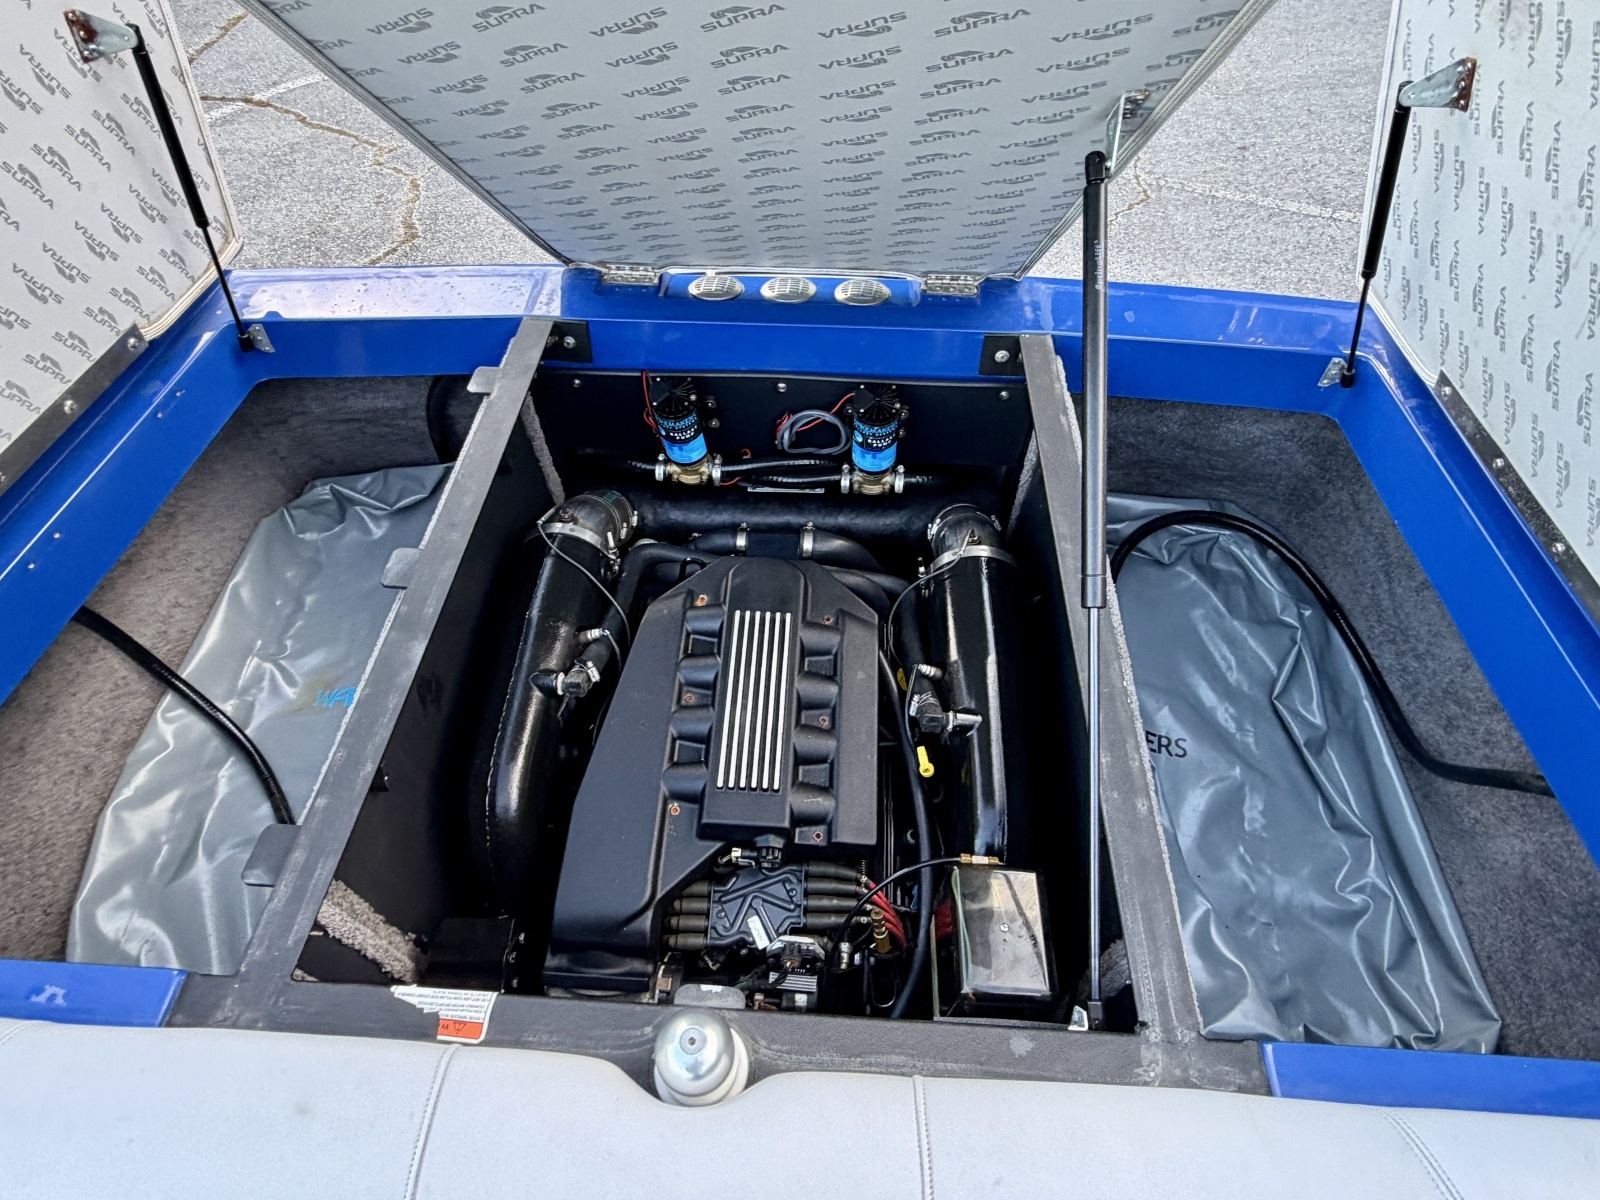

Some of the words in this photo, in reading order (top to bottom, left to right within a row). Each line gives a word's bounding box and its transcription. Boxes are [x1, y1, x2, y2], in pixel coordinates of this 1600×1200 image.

[274, 0, 312, 14] PRA
[471, 4, 546, 33] SUPRA
[700, 4, 786, 33] SUPRA
[366, 9, 435, 35] SUPRA
[589, 7, 668, 37] SUPRA
[817, 12, 908, 39] SUPRA
[933, 10, 1031, 38] SUPRA
[1050, 14, 1154, 44] SUPRA
[1172, 15, 1234, 37] SUP
[317, 39, 354, 50] PRA
[1527, 2, 1536, 69] UPRA
[1554, 0, 1566, 87] SUPRA
[397, 42, 462, 65] SUPRA
[499, 42, 569, 68] SUPRA
[605, 42, 679, 68] SUPRA
[710, 44, 791, 69] SUPRA
[817, 45, 902, 70] SUPRA
[925, 48, 1015, 74] SUPRA
[1035, 48, 1131, 74] SUPRA
[1588, 20, 1600, 110] SUPRA
[20, 43, 72, 100] SUPRA
[349, 67, 386, 78] PRA
[428, 74, 489, 94] SUPRA
[519, 72, 586, 94] SUPRA
[0, 70, 44, 115] SUPR
[621, 76, 691, 98] SUPRA
[717, 74, 792, 96] SUPRA
[818, 79, 897, 101] SUPRA
[919, 78, 1003, 100] SUPRA
[1020, 81, 1108, 104] SUPRA
[451, 99, 510, 118] SUPRA
[541, 101, 603, 120] SUPRA
[633, 102, 699, 121] SUPRA
[724, 104, 795, 123] SUPRA
[819, 105, 893, 124] SUPRA
[913, 107, 991, 126] SUPRA
[1010, 105, 1092, 127] SUPRA
[1496, 79, 1506, 156] SUPRA
[92, 109, 135, 157] SUPRA
[475, 124, 531, 140] SUPRA
[556, 124, 616, 140] SUPRA
[646, 127, 708, 144] SUPRA
[731, 126, 796, 143] SUPRA
[820, 131, 889, 147] SUPRA
[908, 129, 981, 147] SUPRA
[998, 131, 1075, 150] SUPRA
[1524, 100, 1535, 179] SUPRA
[64, 124, 112, 173] SUPRA
[494, 144, 546, 159] SUPRA
[573, 146, 630, 161] SUPRA
[655, 147, 714, 162] SUPRA
[737, 148, 800, 164] SUPRA
[821, 150, 886, 165] SUPRA
[904, 151, 972, 167] SUPRA
[989, 150, 1061, 168] SUPRA
[1550, 120, 1562, 201] SUPRA
[31, 143, 82, 192] SUPRA
[586, 163, 640, 177] SUPRA
[666, 166, 722, 181] SUPRA
[742, 166, 802, 180] SUPRA
[900, 169, 966, 183] SUPRA
[0, 160, 54, 210] SUPRA
[151, 167, 187, 209] SUPRA
[1583, 144, 1597, 228] SUPRA
[129, 183, 169, 225] SUPRA
[101, 202, 143, 244] SUPRA
[1499, 185, 1509, 257] SUPRA
[74, 220, 120, 262] SUPRA
[1527, 210, 1538, 284] SUPRA
[42, 242, 91, 284] SUPRA
[158, 249, 195, 284] SUPRA
[1553, 234, 1565, 310] SUPRA
[12, 262, 64, 305] SUPRA
[136, 266, 175, 302] SUPRA
[109, 286, 151, 325] SUPRA
[1586, 261, 1599, 341] SUPRA
[83, 306, 122, 337] SUPR
[1498, 285, 1507, 354] SUPRA
[1526, 313, 1536, 383] SUPRA
[1481, 356, 1489, 419] SUPRA
[1551, 339, 1562, 412] SUPRA
[0, 380, 41, 414] UPRA
[1582, 372, 1594, 447] SUPRA
[1503, 381, 1512, 446] SUPRA
[1530, 413, 1539, 479] SUPRA
[1555, 441, 1565, 509] SUPRA
[1586, 476, 1597, 547] SUPRA
